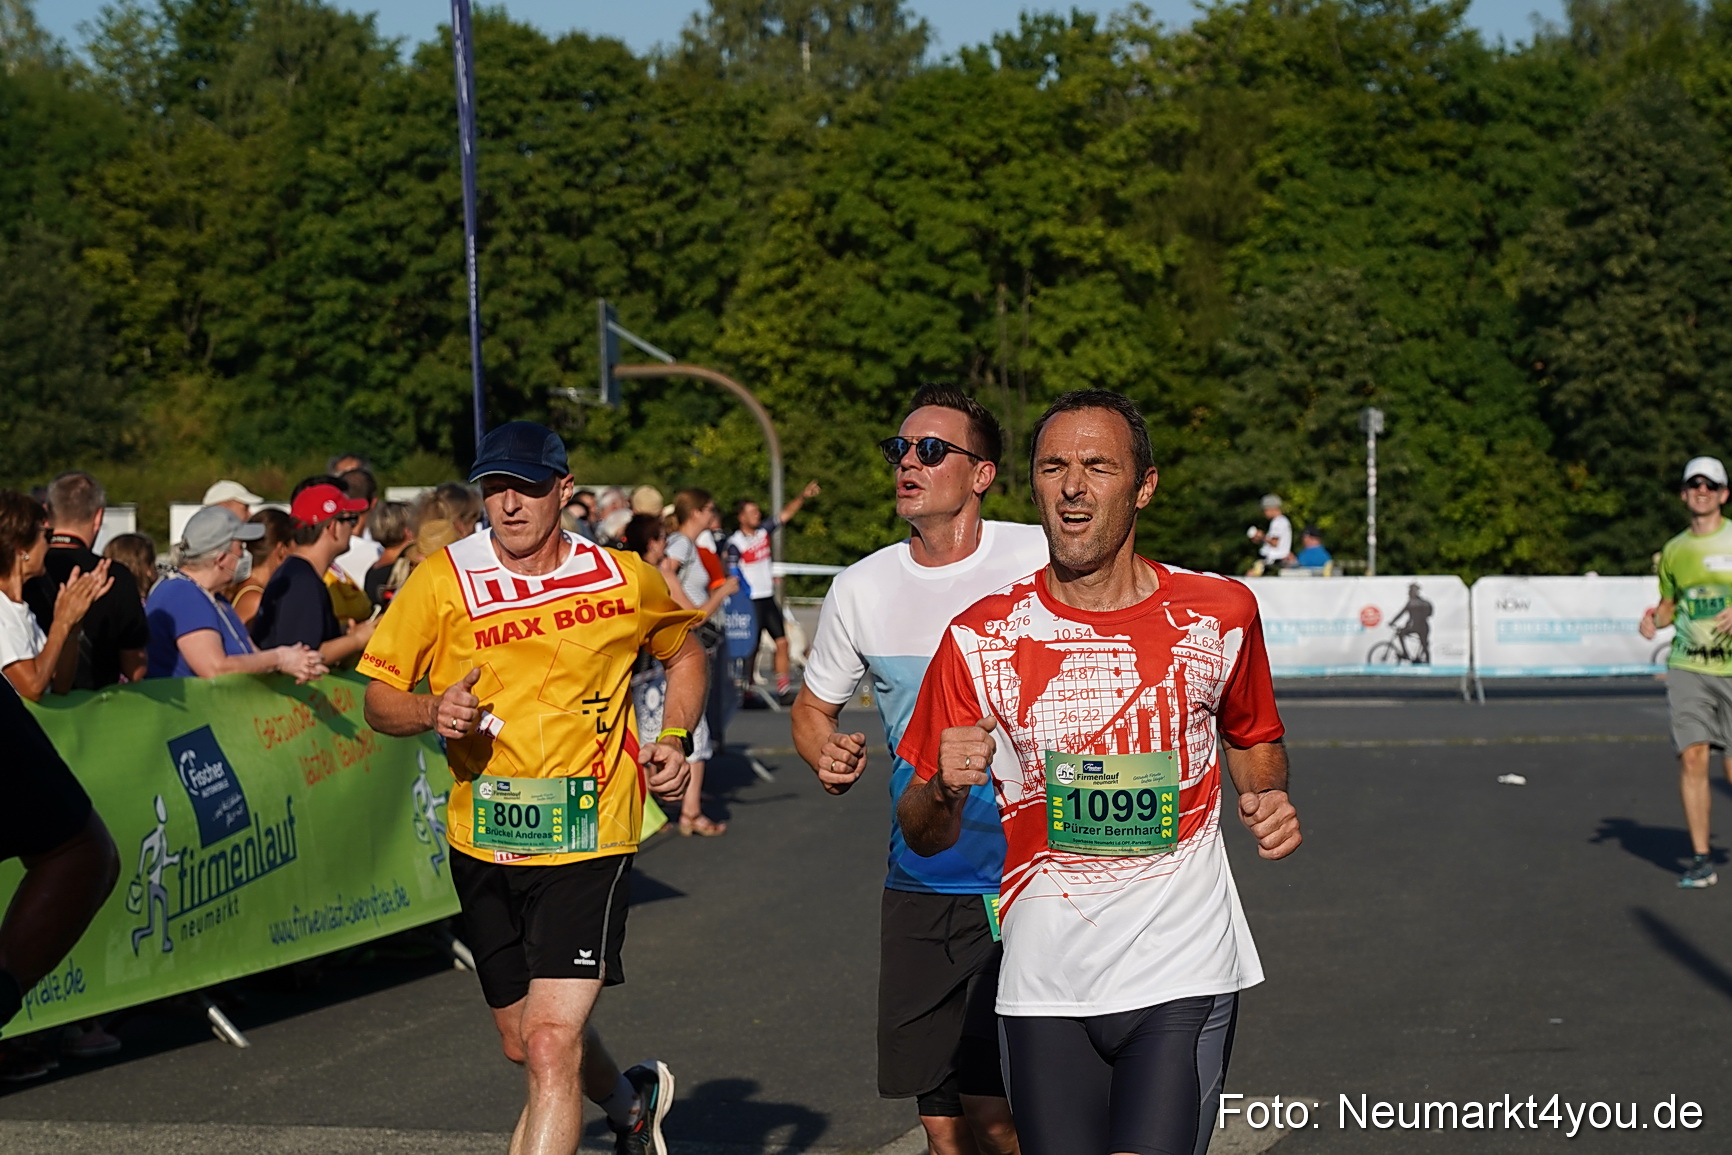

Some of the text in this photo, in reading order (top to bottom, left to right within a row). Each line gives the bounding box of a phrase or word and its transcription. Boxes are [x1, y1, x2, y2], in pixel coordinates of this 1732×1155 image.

[474, 598, 635, 650] MAX BÖGL
[1053, 628, 1093, 640] 10.54
[363, 652, 401, 676] oegl.de
[1058, 709, 1101, 724] 26.22
[1077, 772, 1120, 781] Firmenlauf
[494, 802, 541, 829] 800
[1053, 797, 1064, 831] RUN
[1067, 788, 1158, 822] 1099
[1161, 792, 1173, 838] 2022
[478, 807, 487, 834] RUN
[485, 827, 554, 840] Brückel Andreas
[552, 807, 563, 843] 2022
[1063, 822, 1161, 836] Pürzer Bernhard
[178, 795, 297, 912] firmenlauf
[181, 894, 240, 941] neumarkt
